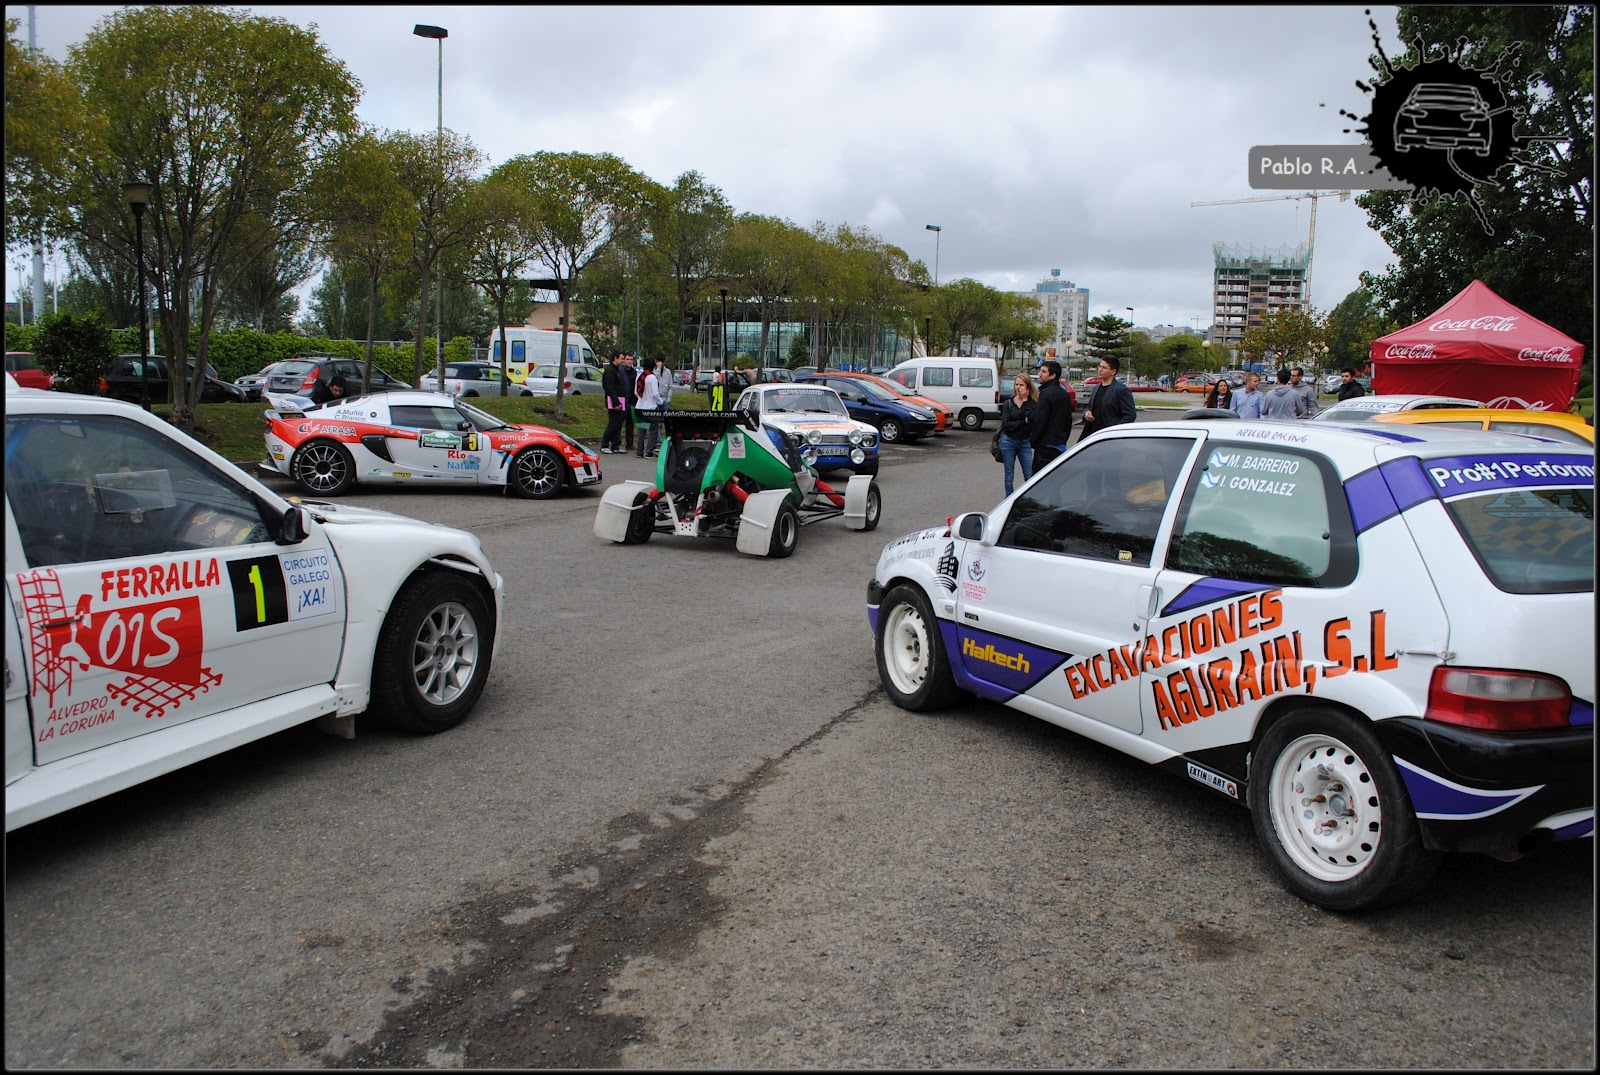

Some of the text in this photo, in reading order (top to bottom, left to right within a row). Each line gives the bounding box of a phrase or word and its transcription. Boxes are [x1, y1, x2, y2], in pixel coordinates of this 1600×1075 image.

[711, 385, 724, 411] 29
[641, 410, 738, 418] www.detailingworks.com
[320, 426, 357, 437] AFRASA
[468, 433, 477, 451] 5
[447, 461, 480, 470] Natura
[1227, 454, 1300, 475] M. BARREIRO
[1429, 460, 1594, 488] Pro#1Perform
[1219, 476, 1297, 497] I. GONZALEZ
[283, 555, 328, 571] CIRCUITO
[100, 558, 221, 602] FERRALLA
[289, 570, 330, 586] GALEGO
[248, 564, 267, 623] 1
[297, 587, 326, 613] ¡XA!
[963, 637, 1031, 674] Haltech
[1063, 588, 1284, 700] EXCAVACIONES
[1151, 630, 1318, 732] AGURAIN,
[47, 695, 109, 723] ALVEDRO
[38, 709, 116, 743] LA CORUÑA
